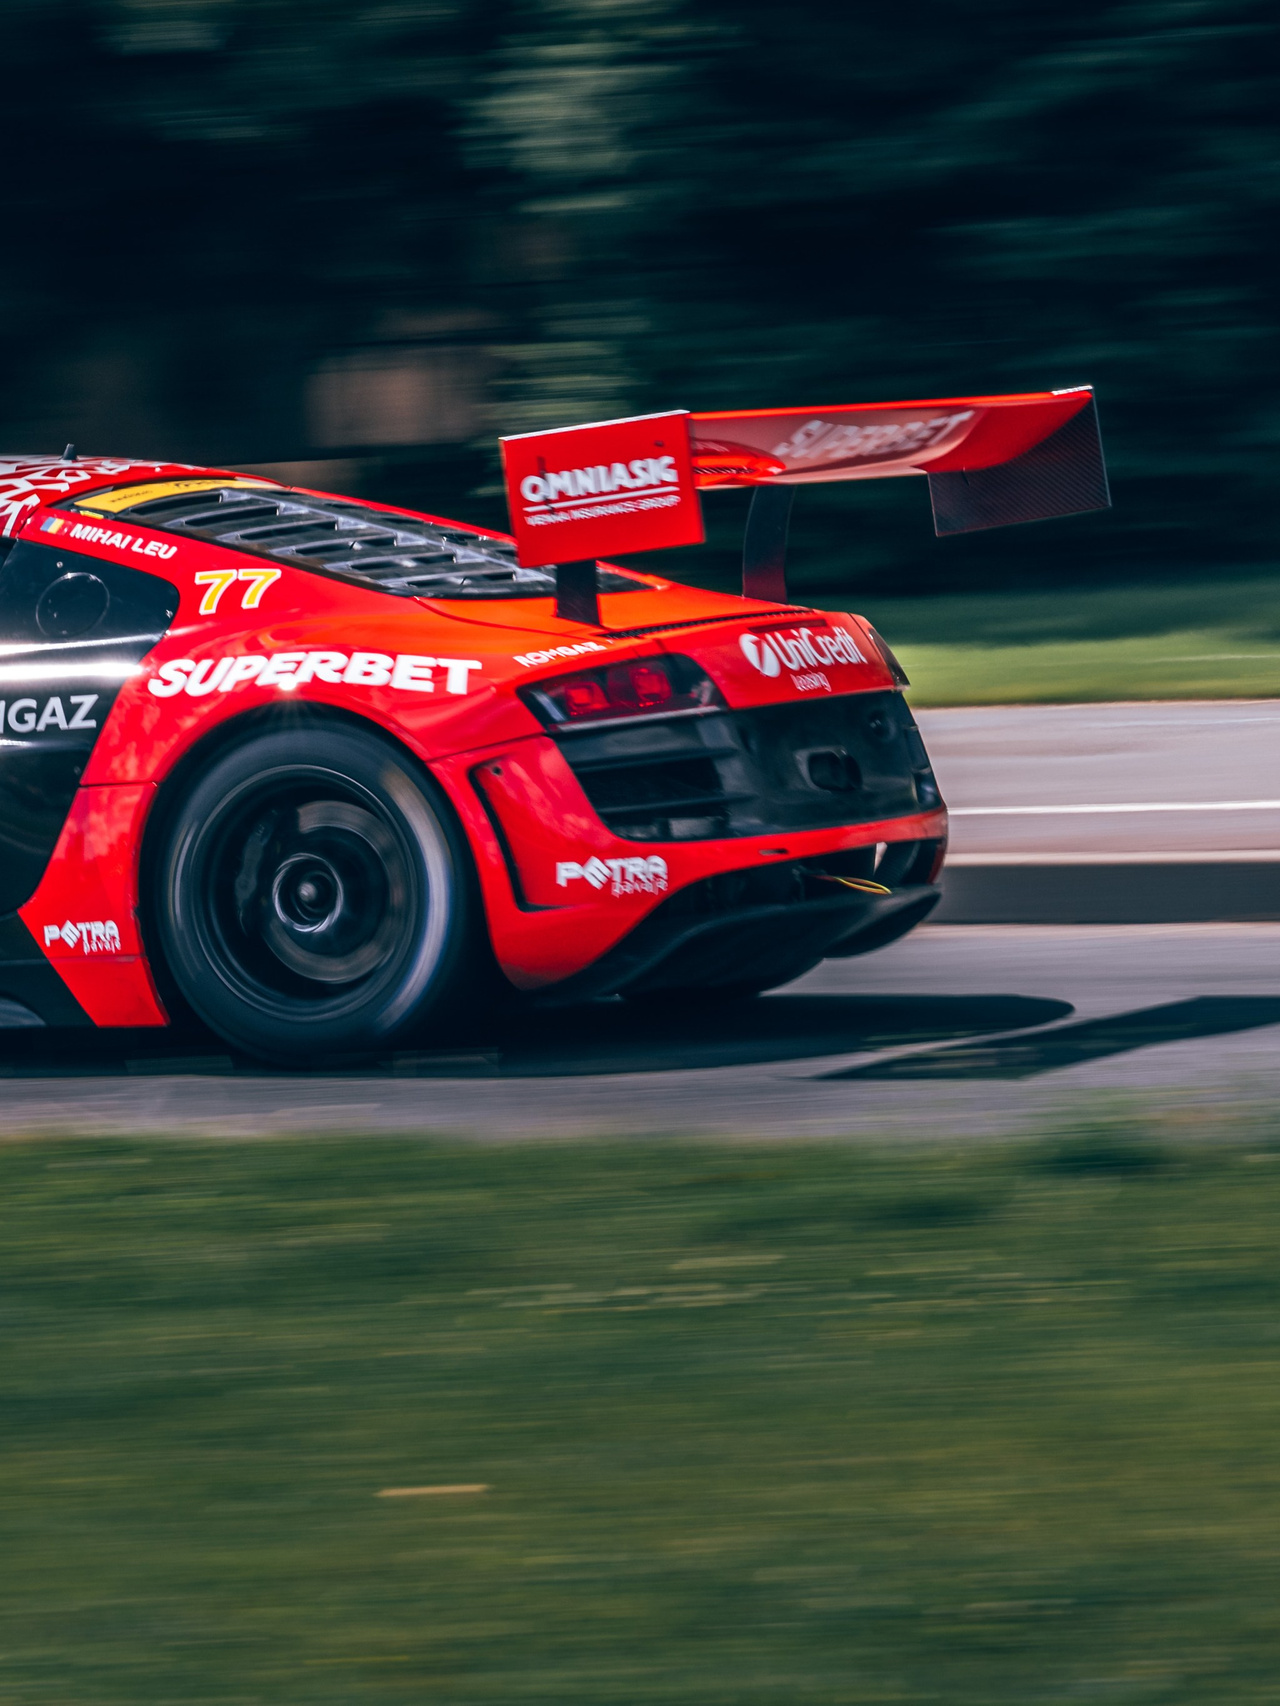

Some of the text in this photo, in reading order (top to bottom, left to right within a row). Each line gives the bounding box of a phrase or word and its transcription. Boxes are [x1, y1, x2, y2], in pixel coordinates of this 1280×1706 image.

[521, 455, 679, 502] OMNIASIG
[69, 523, 178, 560] MIHAI LEU
[195, 568, 282, 615] 77
[512, 641, 608, 668] ROMGAZ
[765, 626, 869, 671] UniCredit
[147, 651, 483, 697] SUPERBET
[555, 855, 668, 890] PETRA
[43, 919, 121, 949] PETRA
